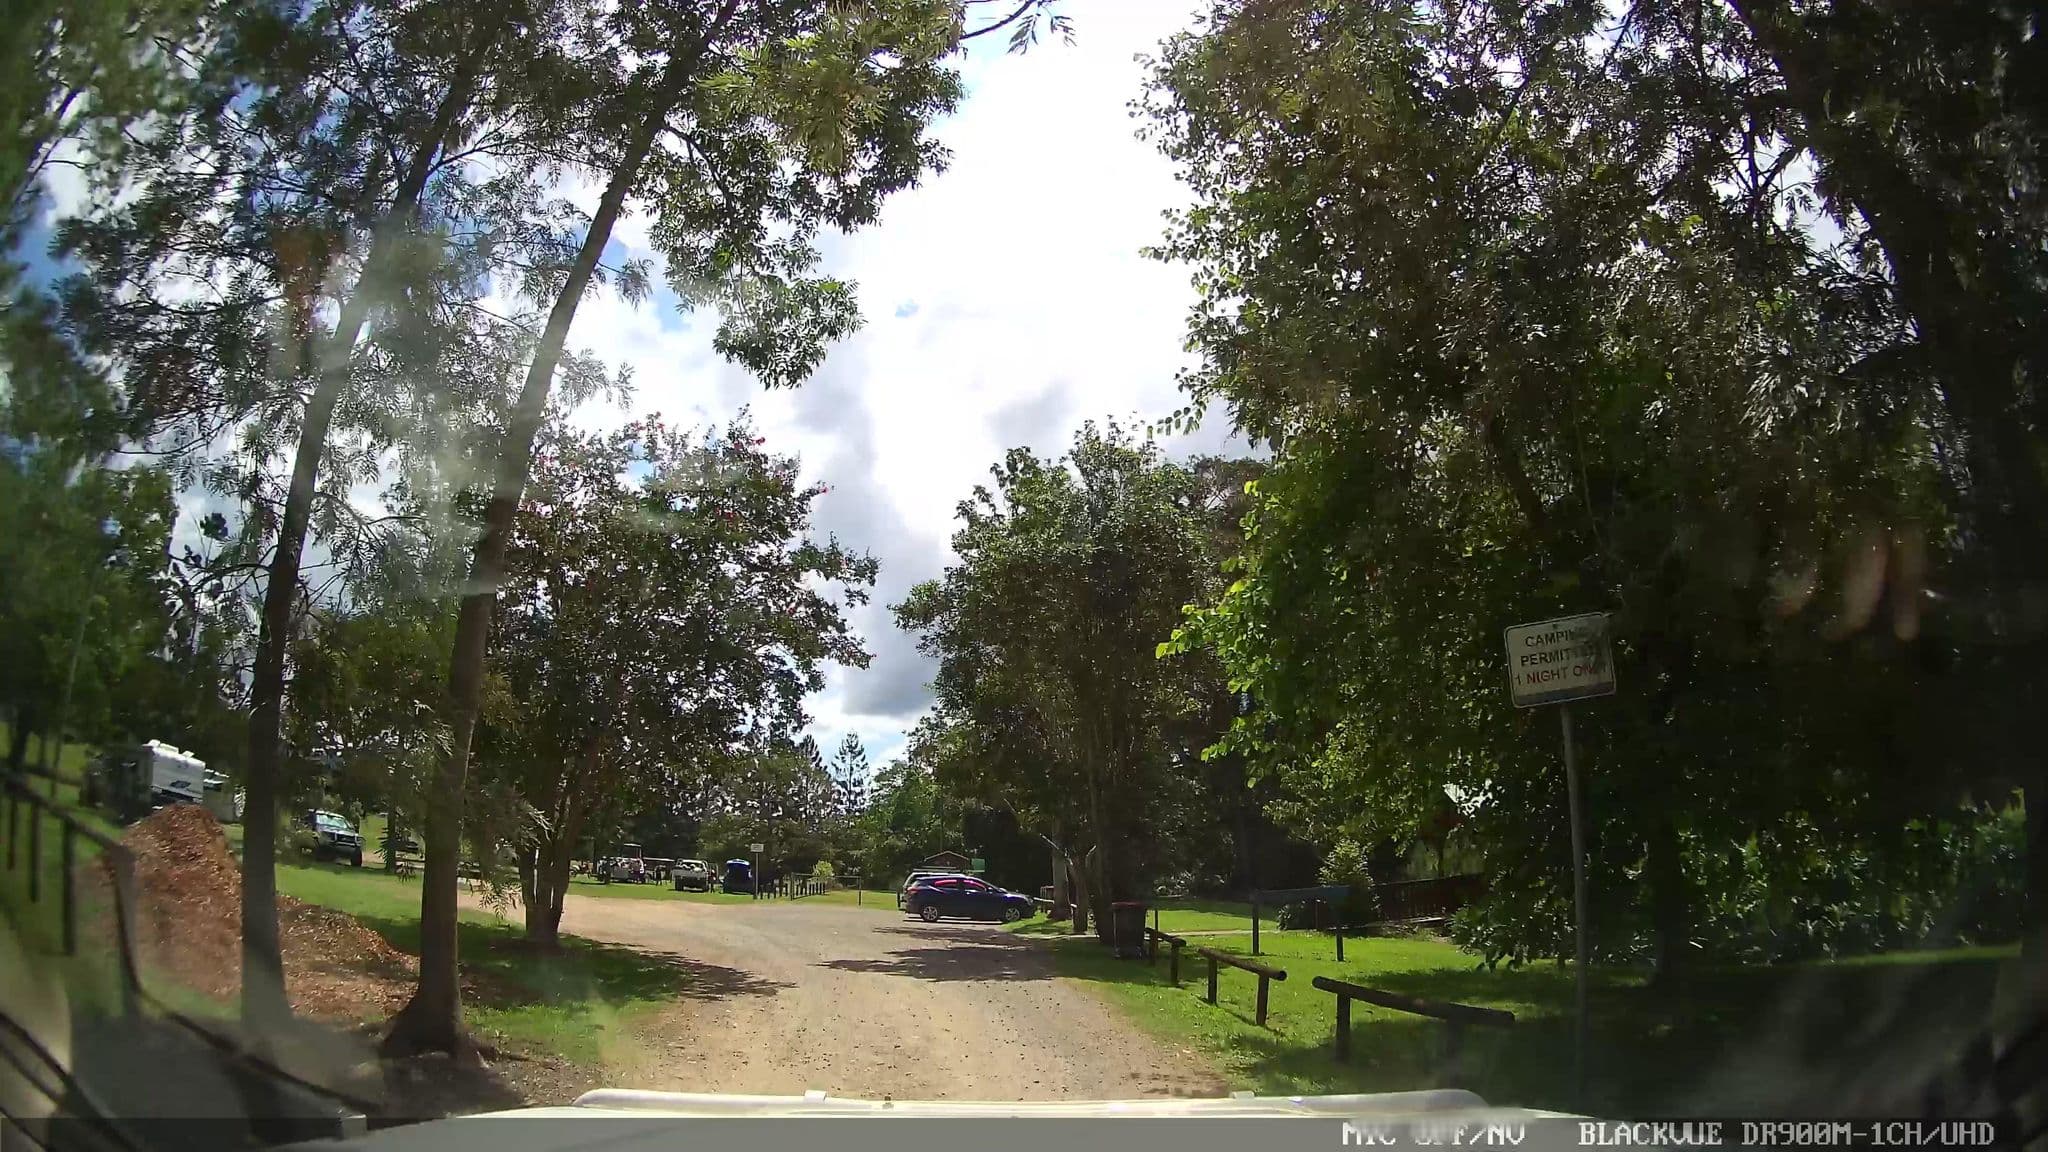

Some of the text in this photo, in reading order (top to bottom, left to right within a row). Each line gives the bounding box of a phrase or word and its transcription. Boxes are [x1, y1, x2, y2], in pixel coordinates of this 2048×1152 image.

[1525, 628, 1586, 647] CAMPI
[1520, 641, 1597, 667] PERMIT
[1514, 674, 1521, 685] 1
[1526, 667, 1568, 684] NIGHT
